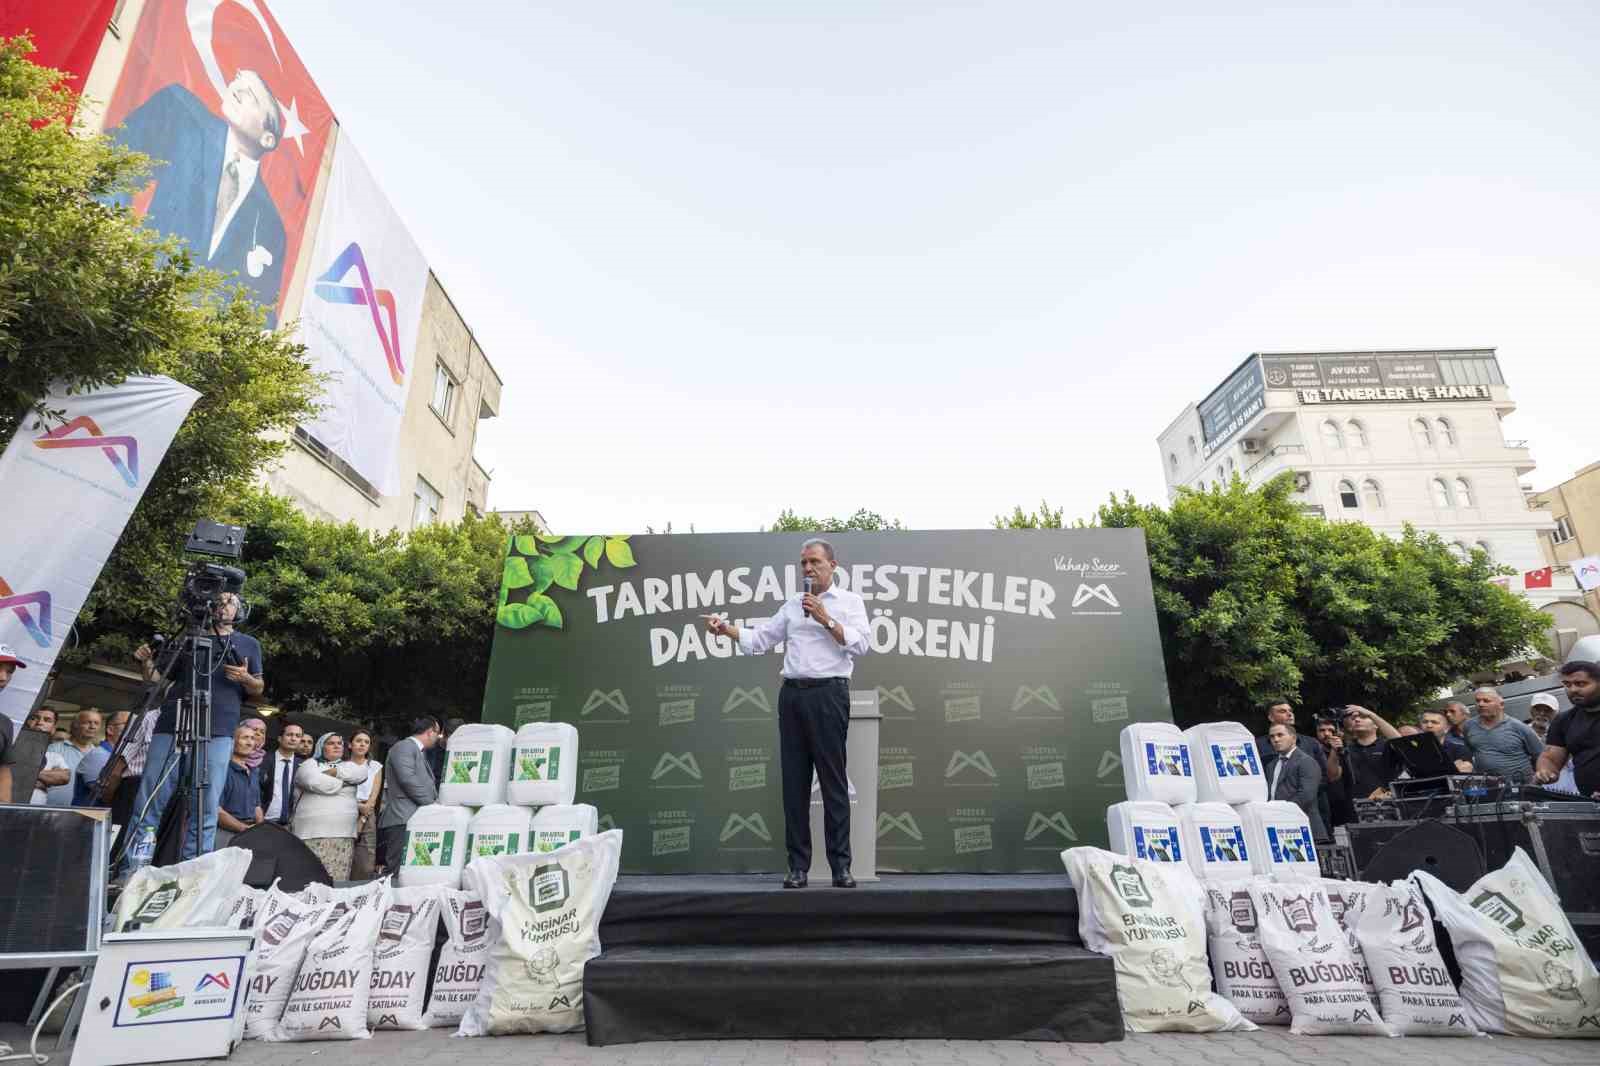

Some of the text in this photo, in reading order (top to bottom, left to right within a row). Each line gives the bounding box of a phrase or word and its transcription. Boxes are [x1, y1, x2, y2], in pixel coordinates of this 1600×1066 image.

[1321, 387, 1408, 401] TANERLER
[1411, 386, 1430, 401] İŞ
[869, 608, 995, 664] ÖRENİ
[521, 920, 580, 943] YUMRUSU
[369, 966, 416, 989] ĞDAY
[435, 960, 486, 983] BUĞDA
[1223, 956, 1275, 979] BUĞD
[1289, 960, 1356, 987] BUĞDA
[1388, 962, 1450, 986] BUĞDA
[313, 1000, 352, 1011] SATILMAZ
[372, 1000, 408, 1009] SATILMAZ
